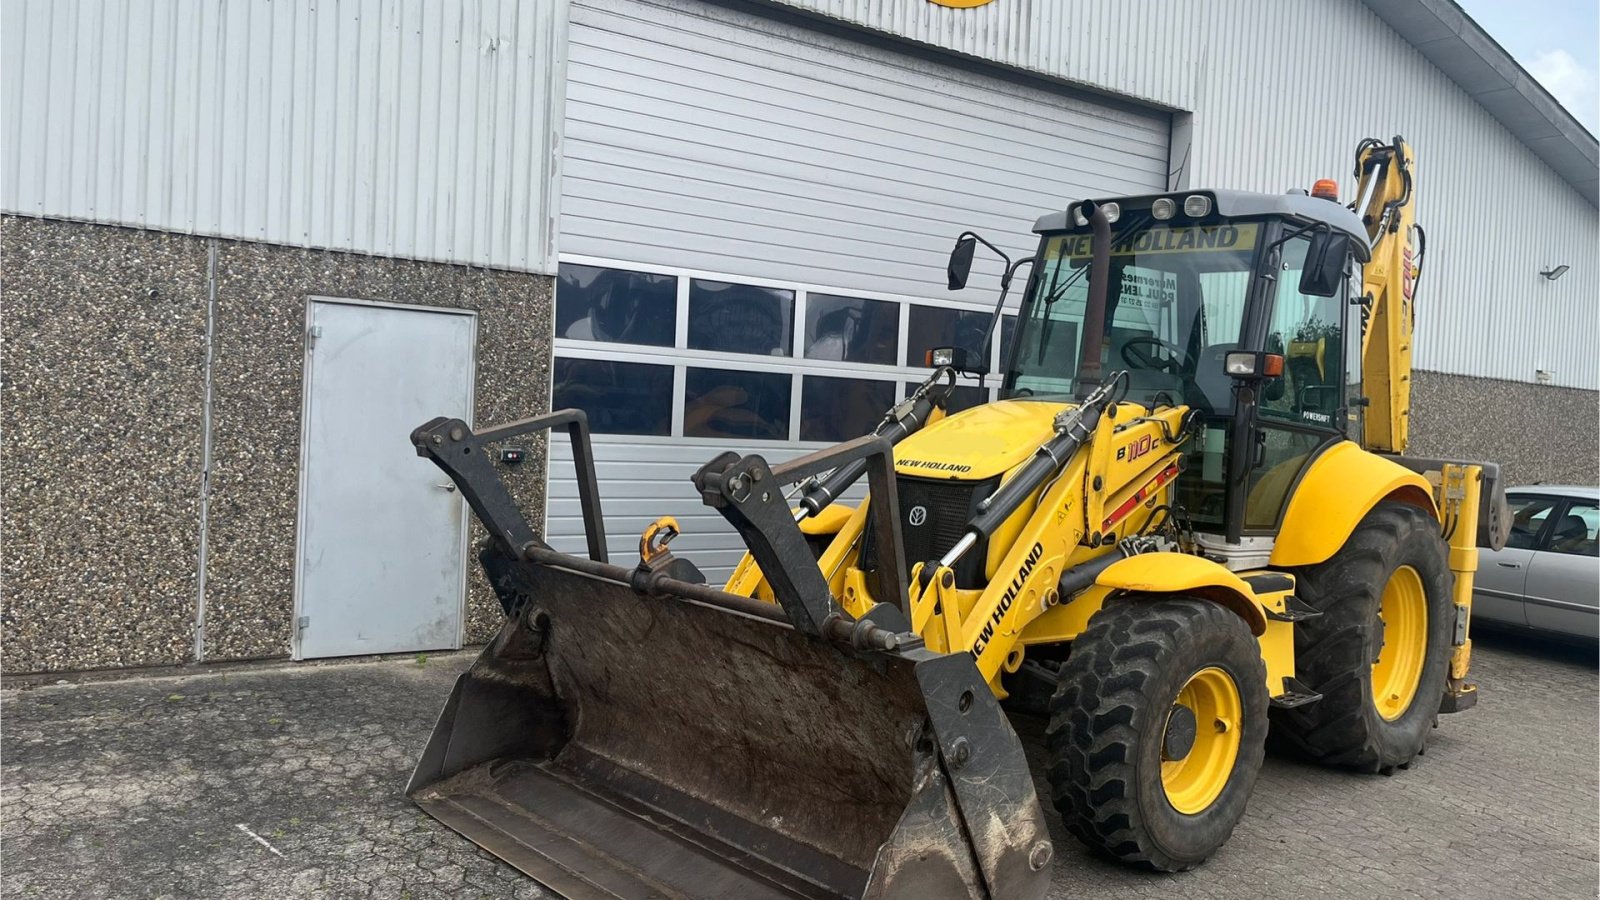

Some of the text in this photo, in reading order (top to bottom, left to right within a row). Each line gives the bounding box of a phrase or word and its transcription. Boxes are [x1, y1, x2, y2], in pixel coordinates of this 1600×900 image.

[1059, 227, 1239, 257] NE HOLLAND
[1116, 447, 1126, 461] B
[1128, 433, 1152, 463] 110
[896, 459, 972, 473] NEW HOLLAND
[992, 541, 1043, 625] HOLLAND
